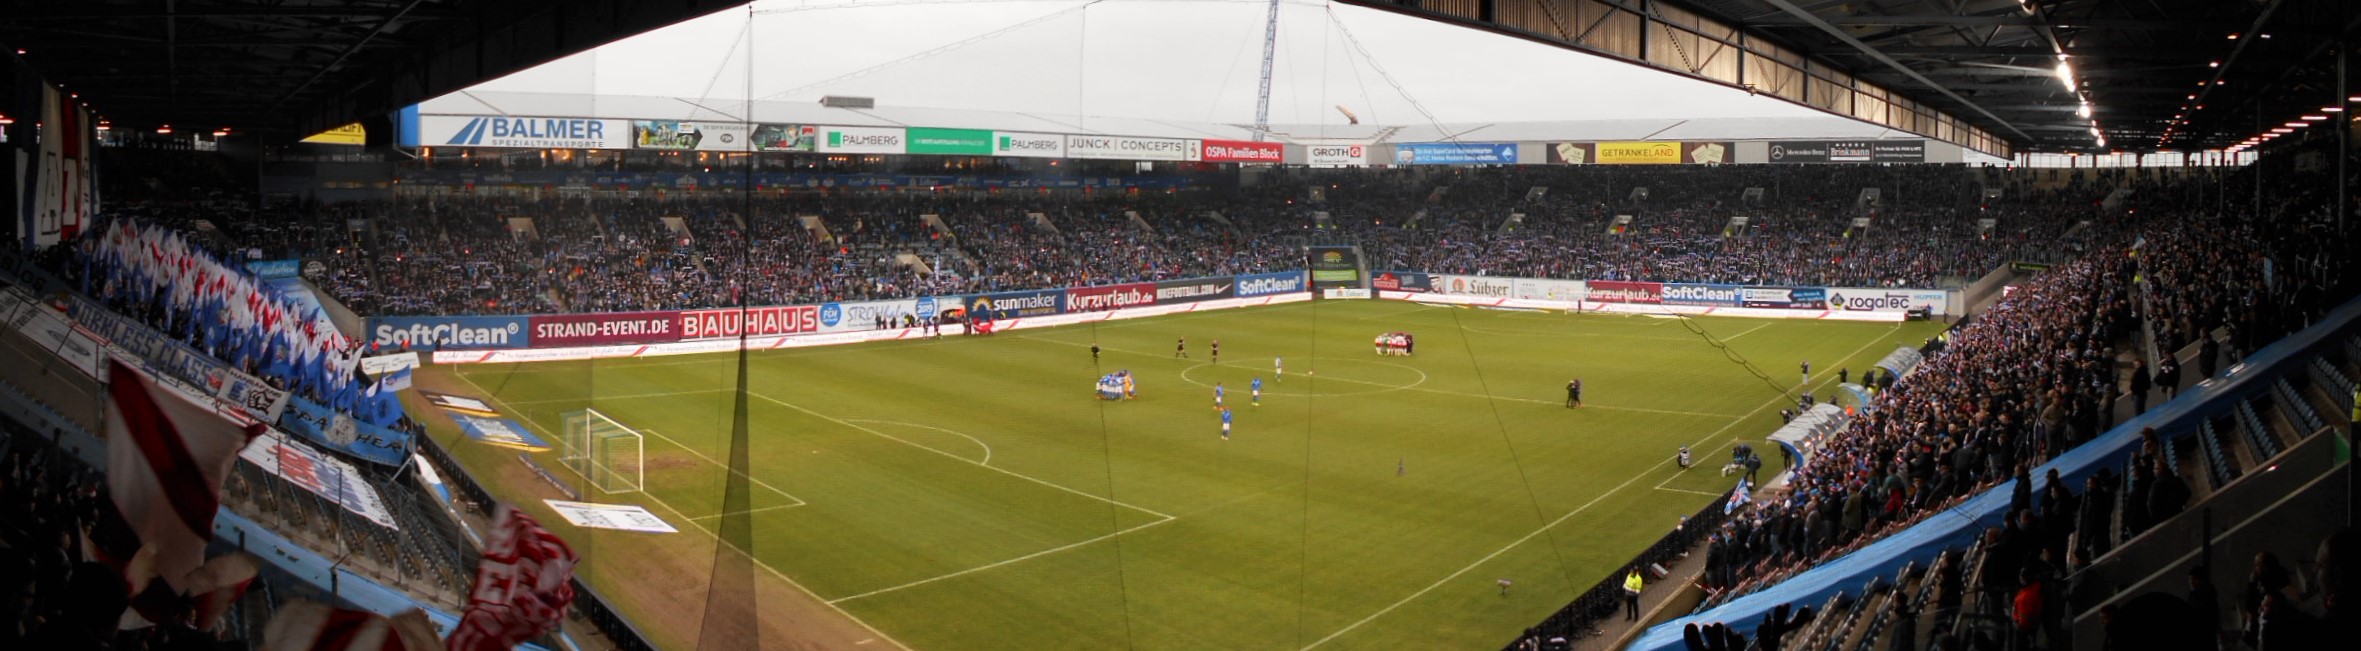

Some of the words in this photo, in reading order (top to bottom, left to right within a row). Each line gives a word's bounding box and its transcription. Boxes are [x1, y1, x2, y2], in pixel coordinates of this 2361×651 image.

[492, 118, 603, 139] BALMER
[492, 139, 604, 148] SPEZIALTRANSPORTE
[843, 135, 899, 146] PALMBERG
[1011, 139, 1058, 150] PALMBERG
[1070, 139, 1111, 149] JUNCK
[1121, 140, 1182, 152] CONCEPTS
[1206, 146, 1227, 157] OSPA
[1227, 147, 1258, 158] Familien
[1259, 149, 1280, 159] Block
[1313, 148, 1349, 156] GROTH
[1602, 147, 1674, 157] GETRÄNKELAND
[1830, 147, 1870, 156] Brinkmann
[1157, 283, 1215, 299] NIKEFOOTBALL.COM
[1469, 279, 1509, 297] Lübzer
[994, 294, 1057, 311] sunmaker
[1067, 288, 1153, 310] Kurzurlaub.de
[1849, 292, 1909, 311] rogatec
[537, 319, 670, 338] STRAND-EVENT.DE
[684, 308, 815, 336] BAUHAUS
[158, 341, 212, 385] CLASS
